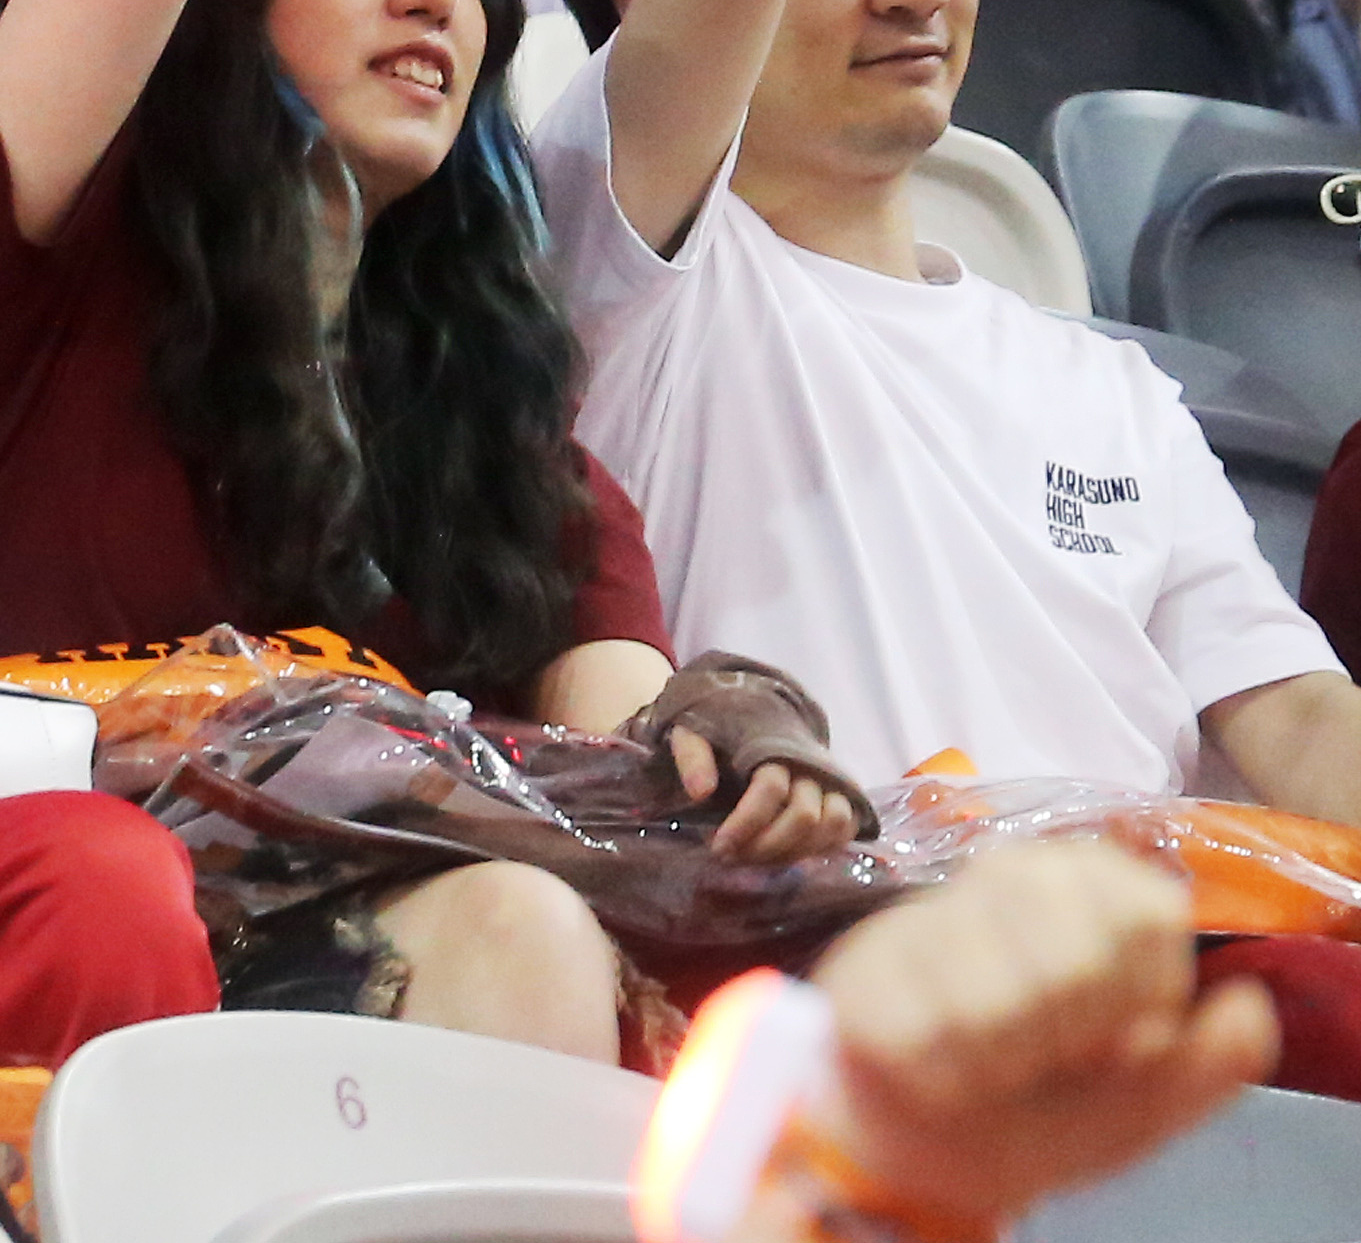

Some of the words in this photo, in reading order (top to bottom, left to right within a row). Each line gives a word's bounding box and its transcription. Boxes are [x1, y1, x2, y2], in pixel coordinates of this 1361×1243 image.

[1046, 460, 1140, 504] KARASUNO
[1046, 491, 1085, 529] HIGH
[1049, 524, 1122, 555] SCHOOL
[336, 1076, 368, 1131] 6
